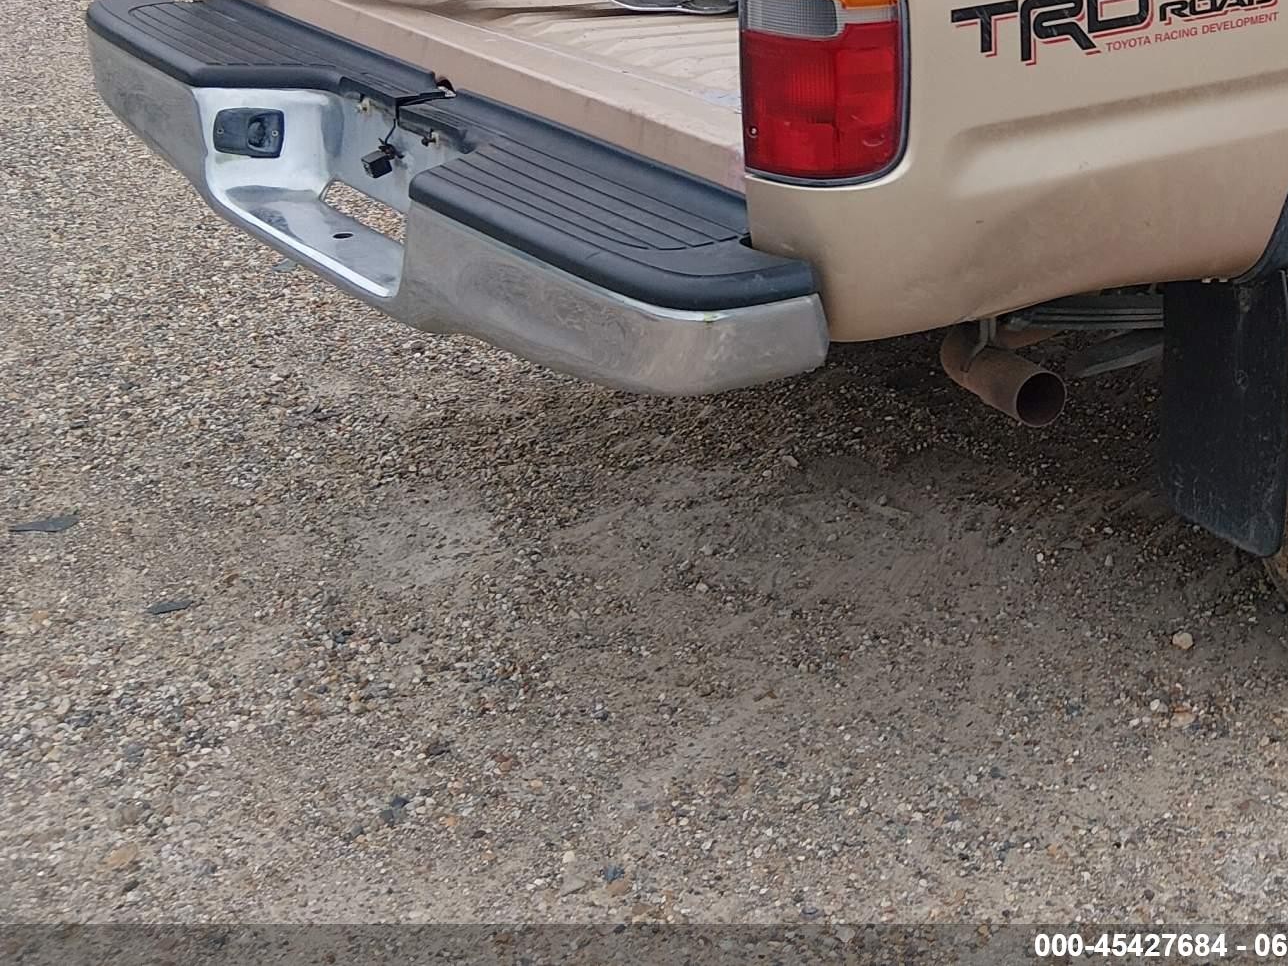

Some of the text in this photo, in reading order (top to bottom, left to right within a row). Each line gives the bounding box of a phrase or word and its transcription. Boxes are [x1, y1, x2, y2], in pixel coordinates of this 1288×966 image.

[1105, 11, 1280, 52] TOYOTA RACING DEVELOPMENT
